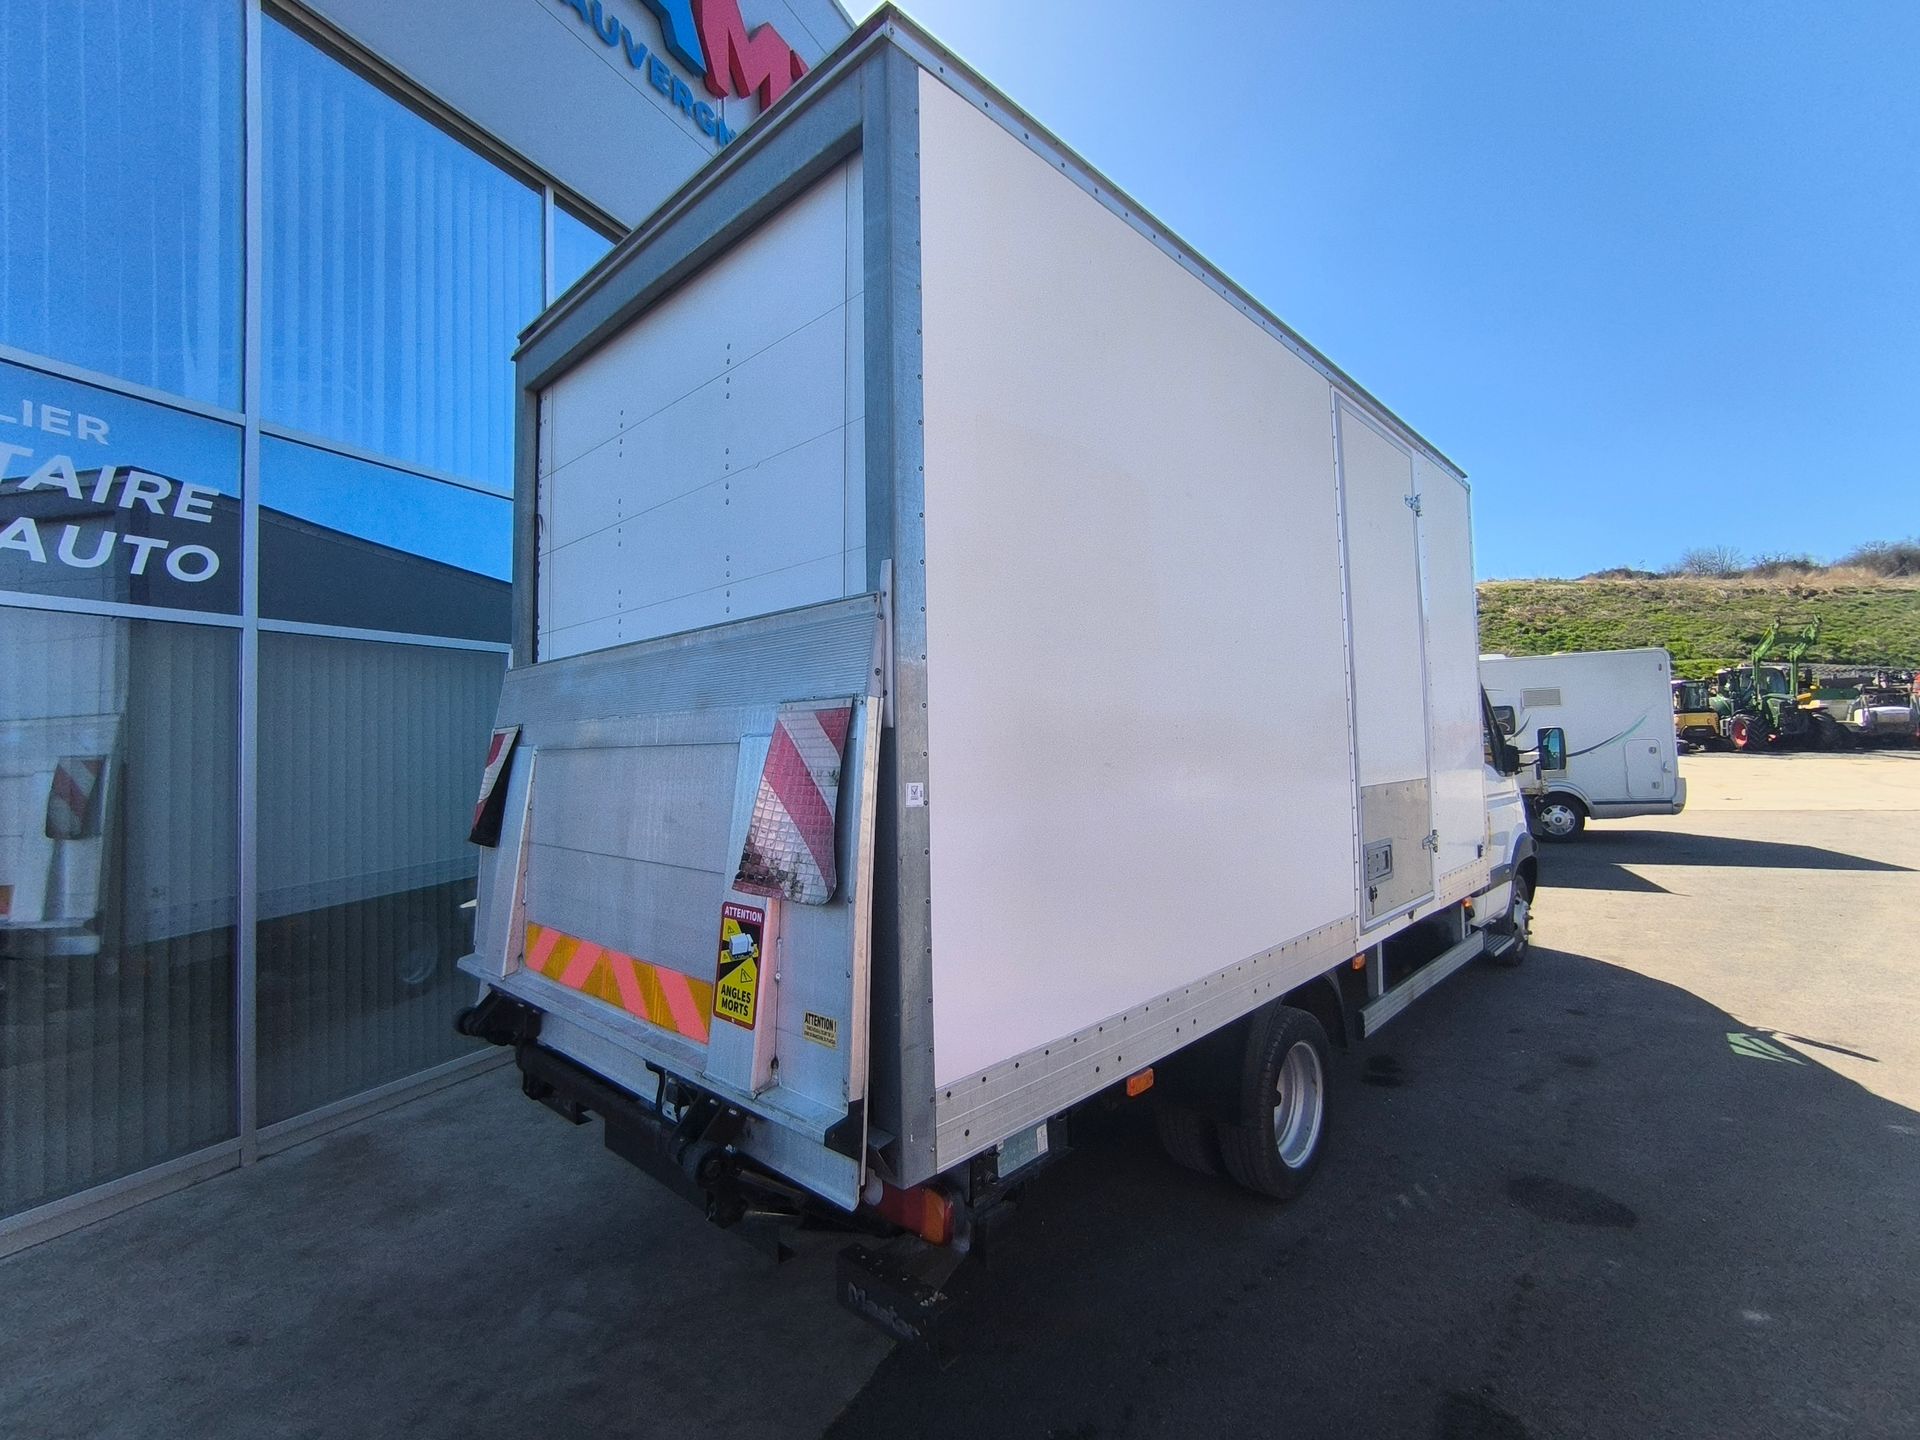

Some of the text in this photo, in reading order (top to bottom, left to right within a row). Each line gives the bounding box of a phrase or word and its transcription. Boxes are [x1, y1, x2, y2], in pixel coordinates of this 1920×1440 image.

[0, 516, 220, 583] AUTO
[724, 905, 763, 923] ATTENTION
[720, 984, 752, 1003] ANGLES
[721, 997, 749, 1017] MORTS
[804, 1011, 834, 1032] ATTENTION
